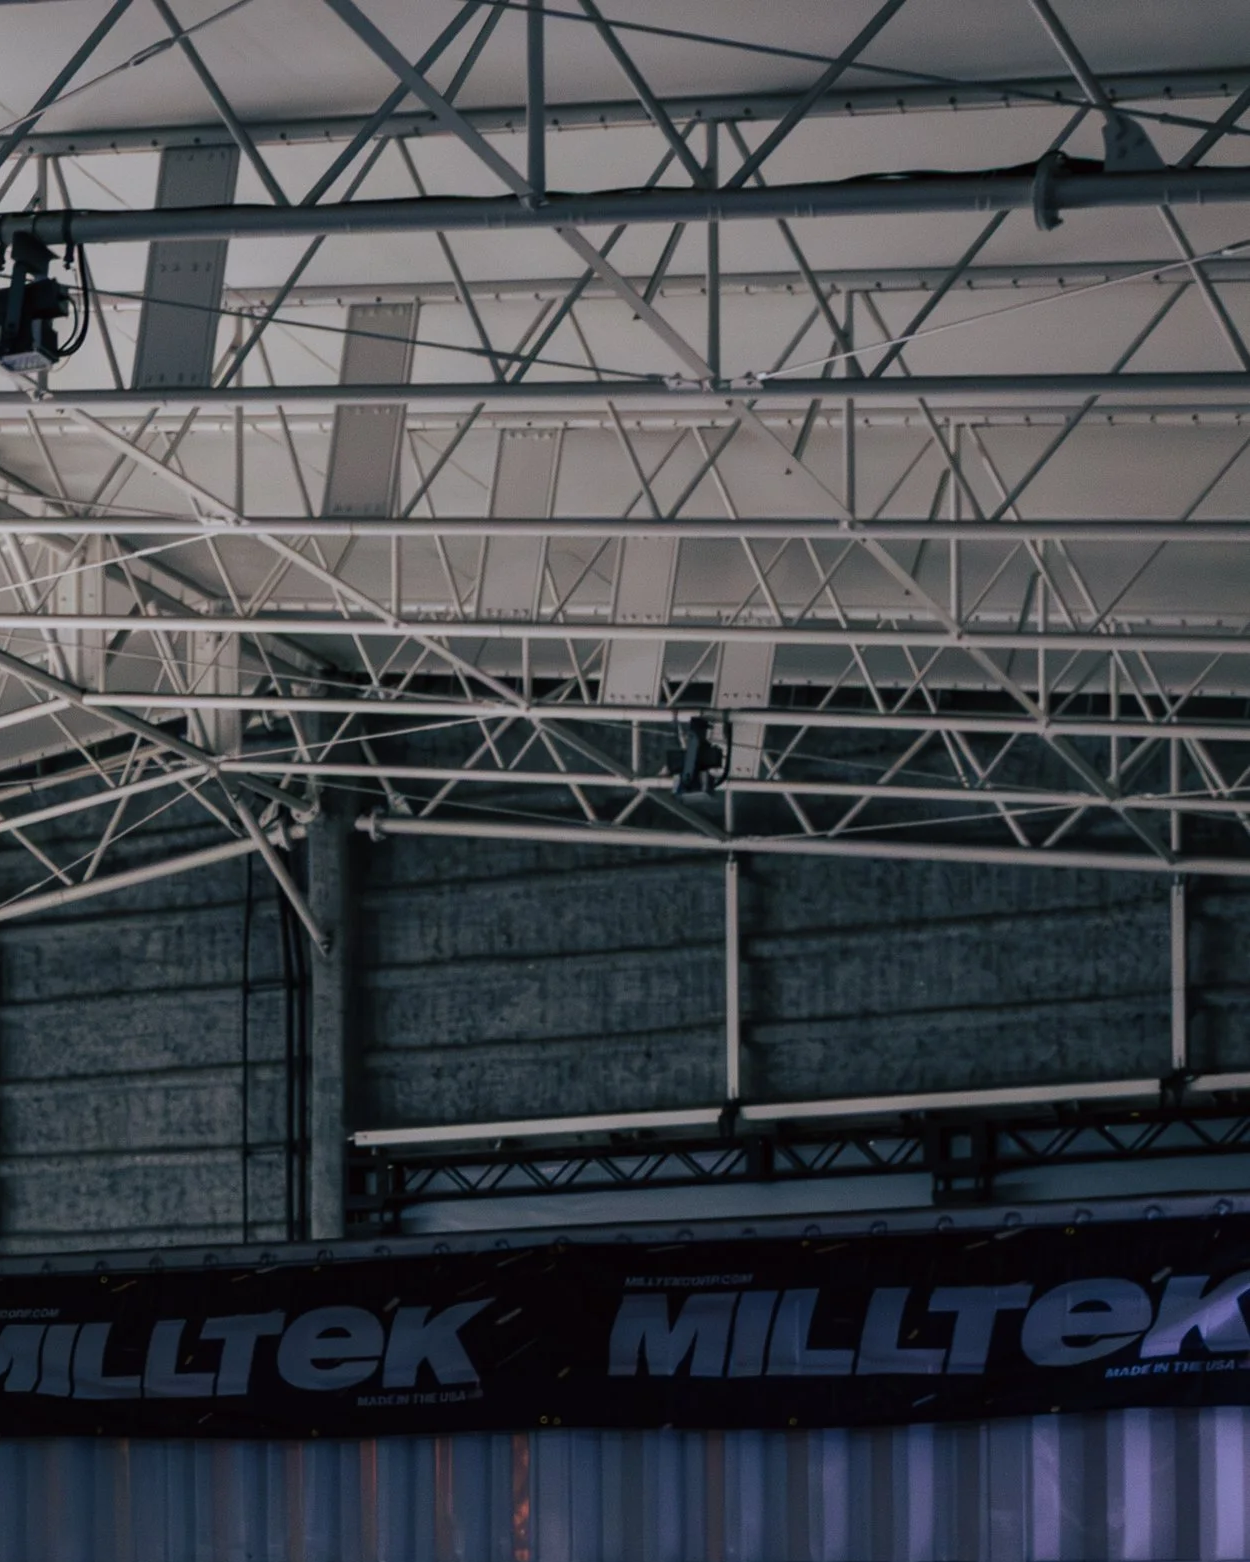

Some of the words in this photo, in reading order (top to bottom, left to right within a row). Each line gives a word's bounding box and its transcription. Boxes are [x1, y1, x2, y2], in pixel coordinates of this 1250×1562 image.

[1104, 1364, 1150, 1379] MADE
[1152, 1362, 1170, 1373] IN
[1206, 1359, 1236, 1372] USA
[440, 1390, 466, 1402] USA
